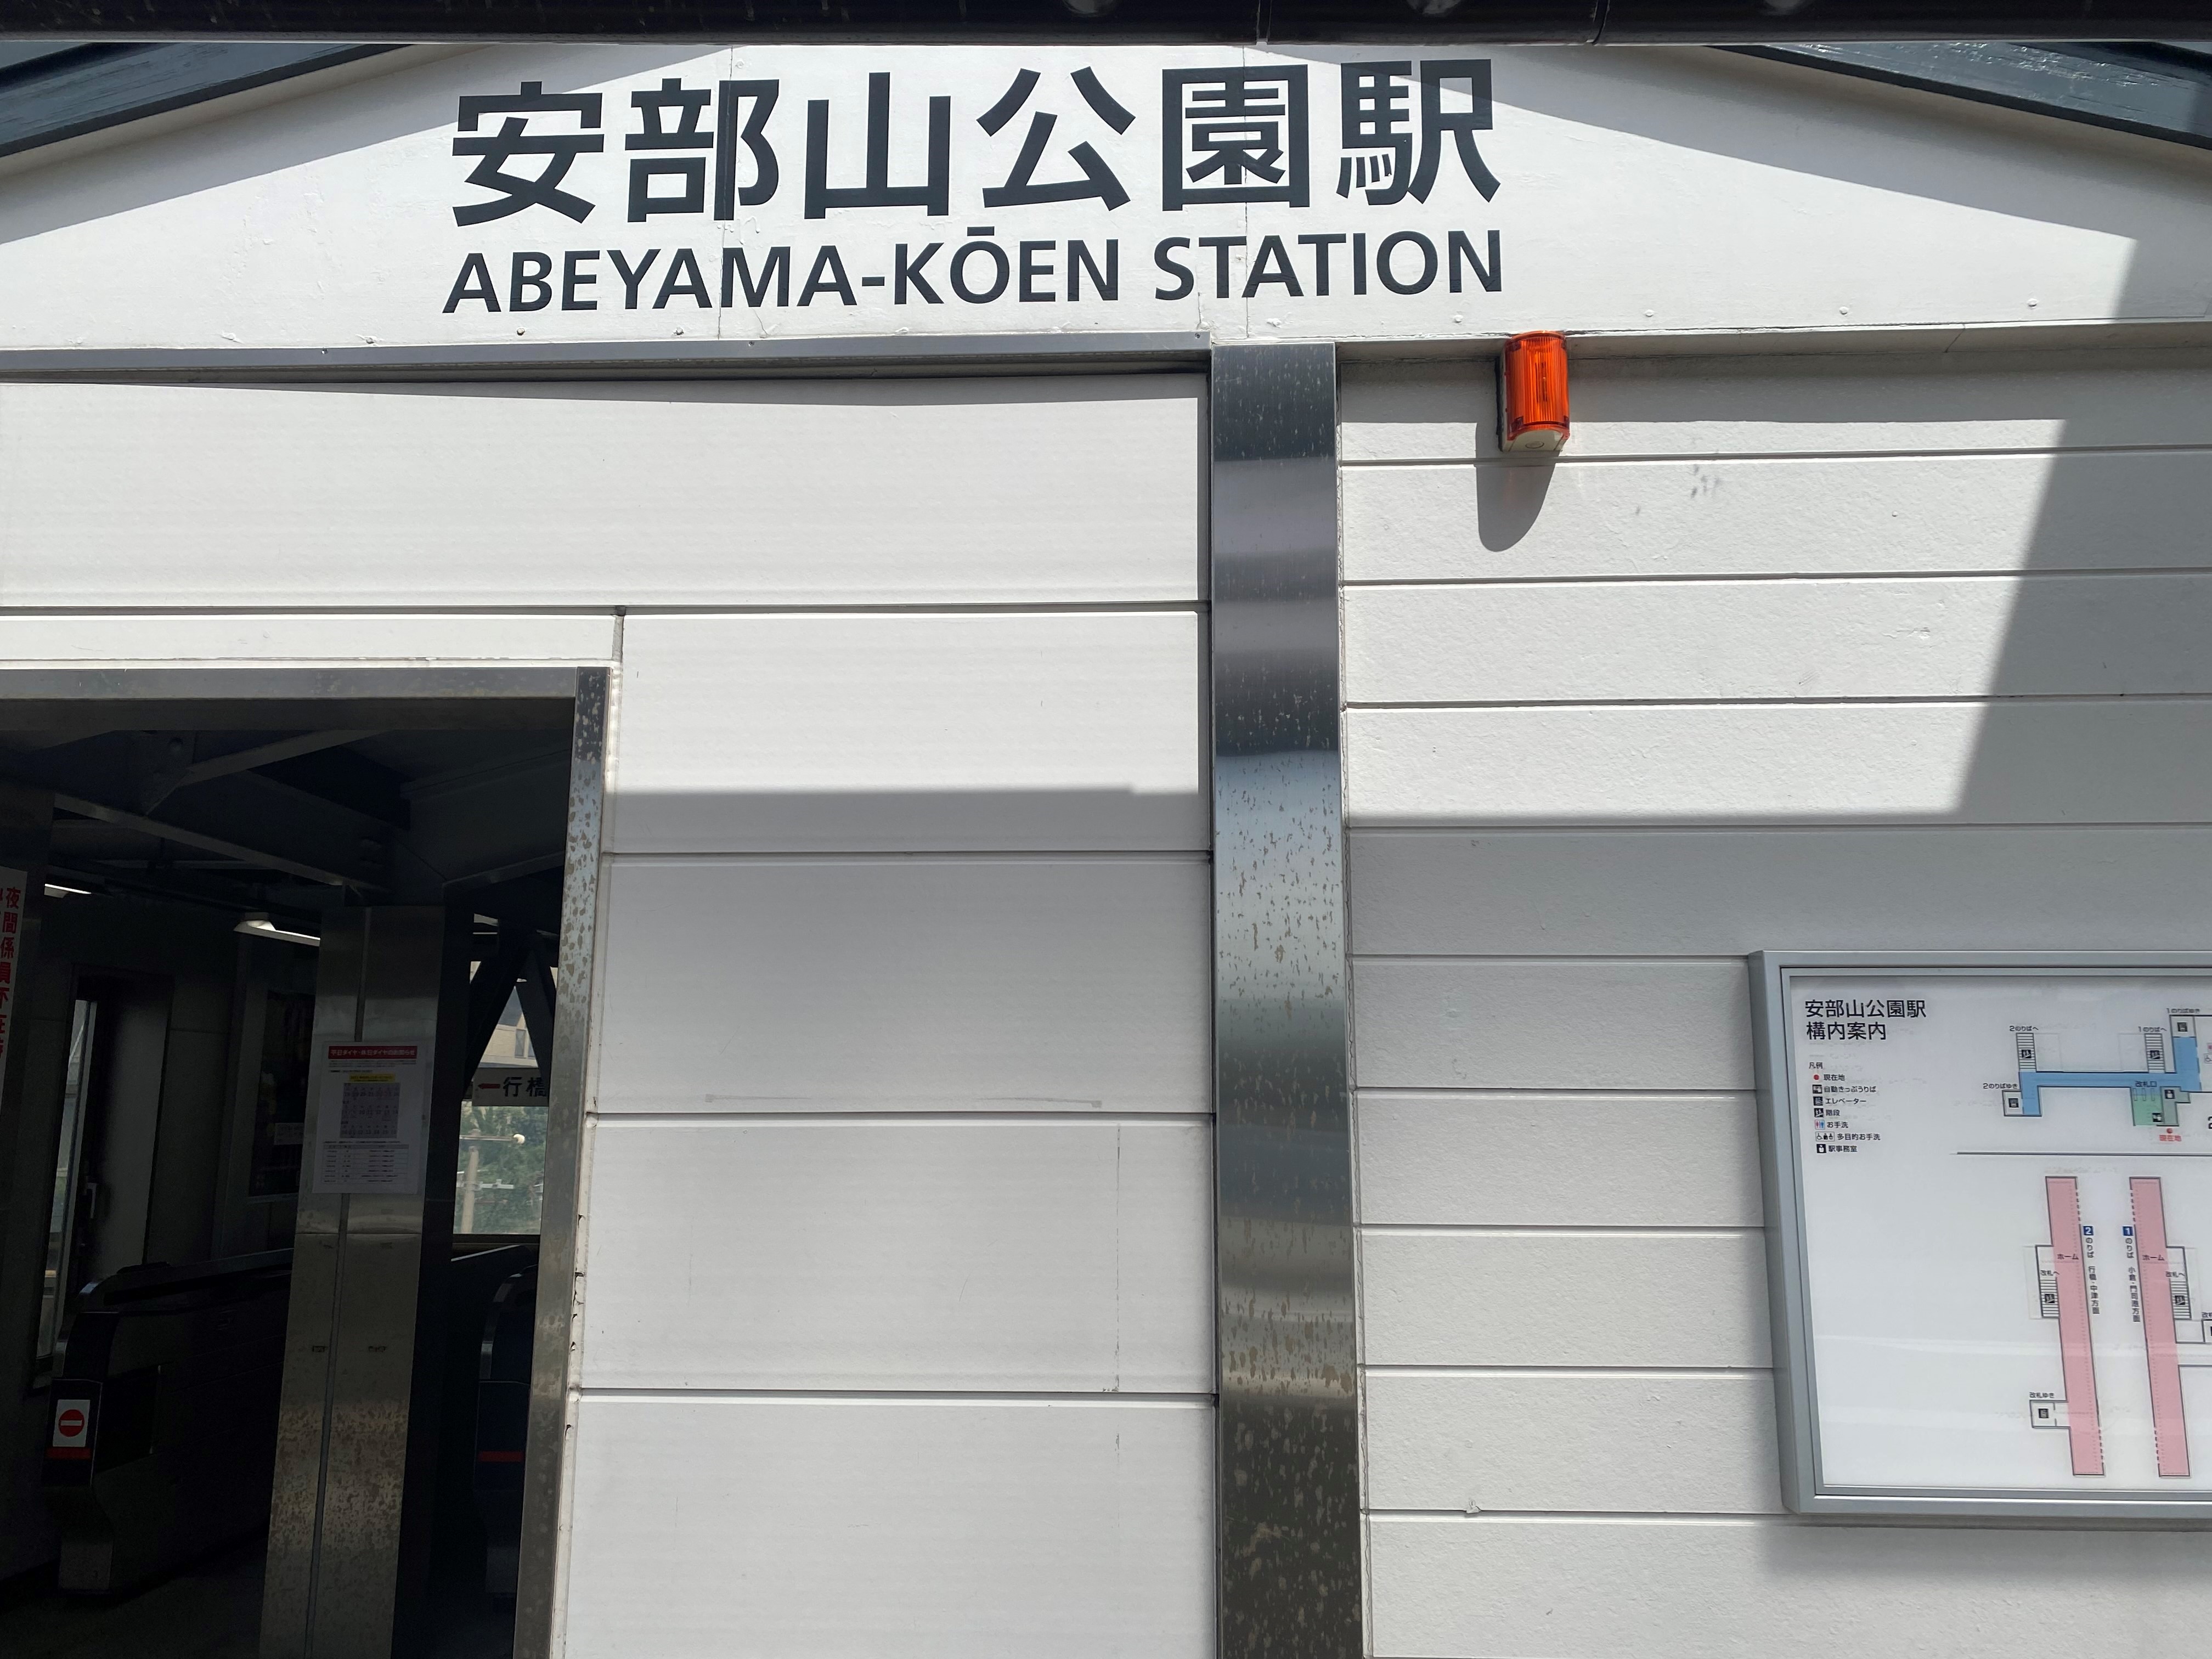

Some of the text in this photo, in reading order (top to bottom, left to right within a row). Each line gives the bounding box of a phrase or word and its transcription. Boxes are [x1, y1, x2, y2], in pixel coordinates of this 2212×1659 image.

[452, 59, 1502, 227] 安部山公園駅
[442, 226, 1502, 313] ABEYAMA-KŌEN STATION
[1805, 999, 1927, 1018] 安部山公園駅
[1806, 1021, 1887, 1040] 構内案内
[2085, 1237, 2095, 1259] のりば
[2125, 1238, 2135, 1259] のりば
